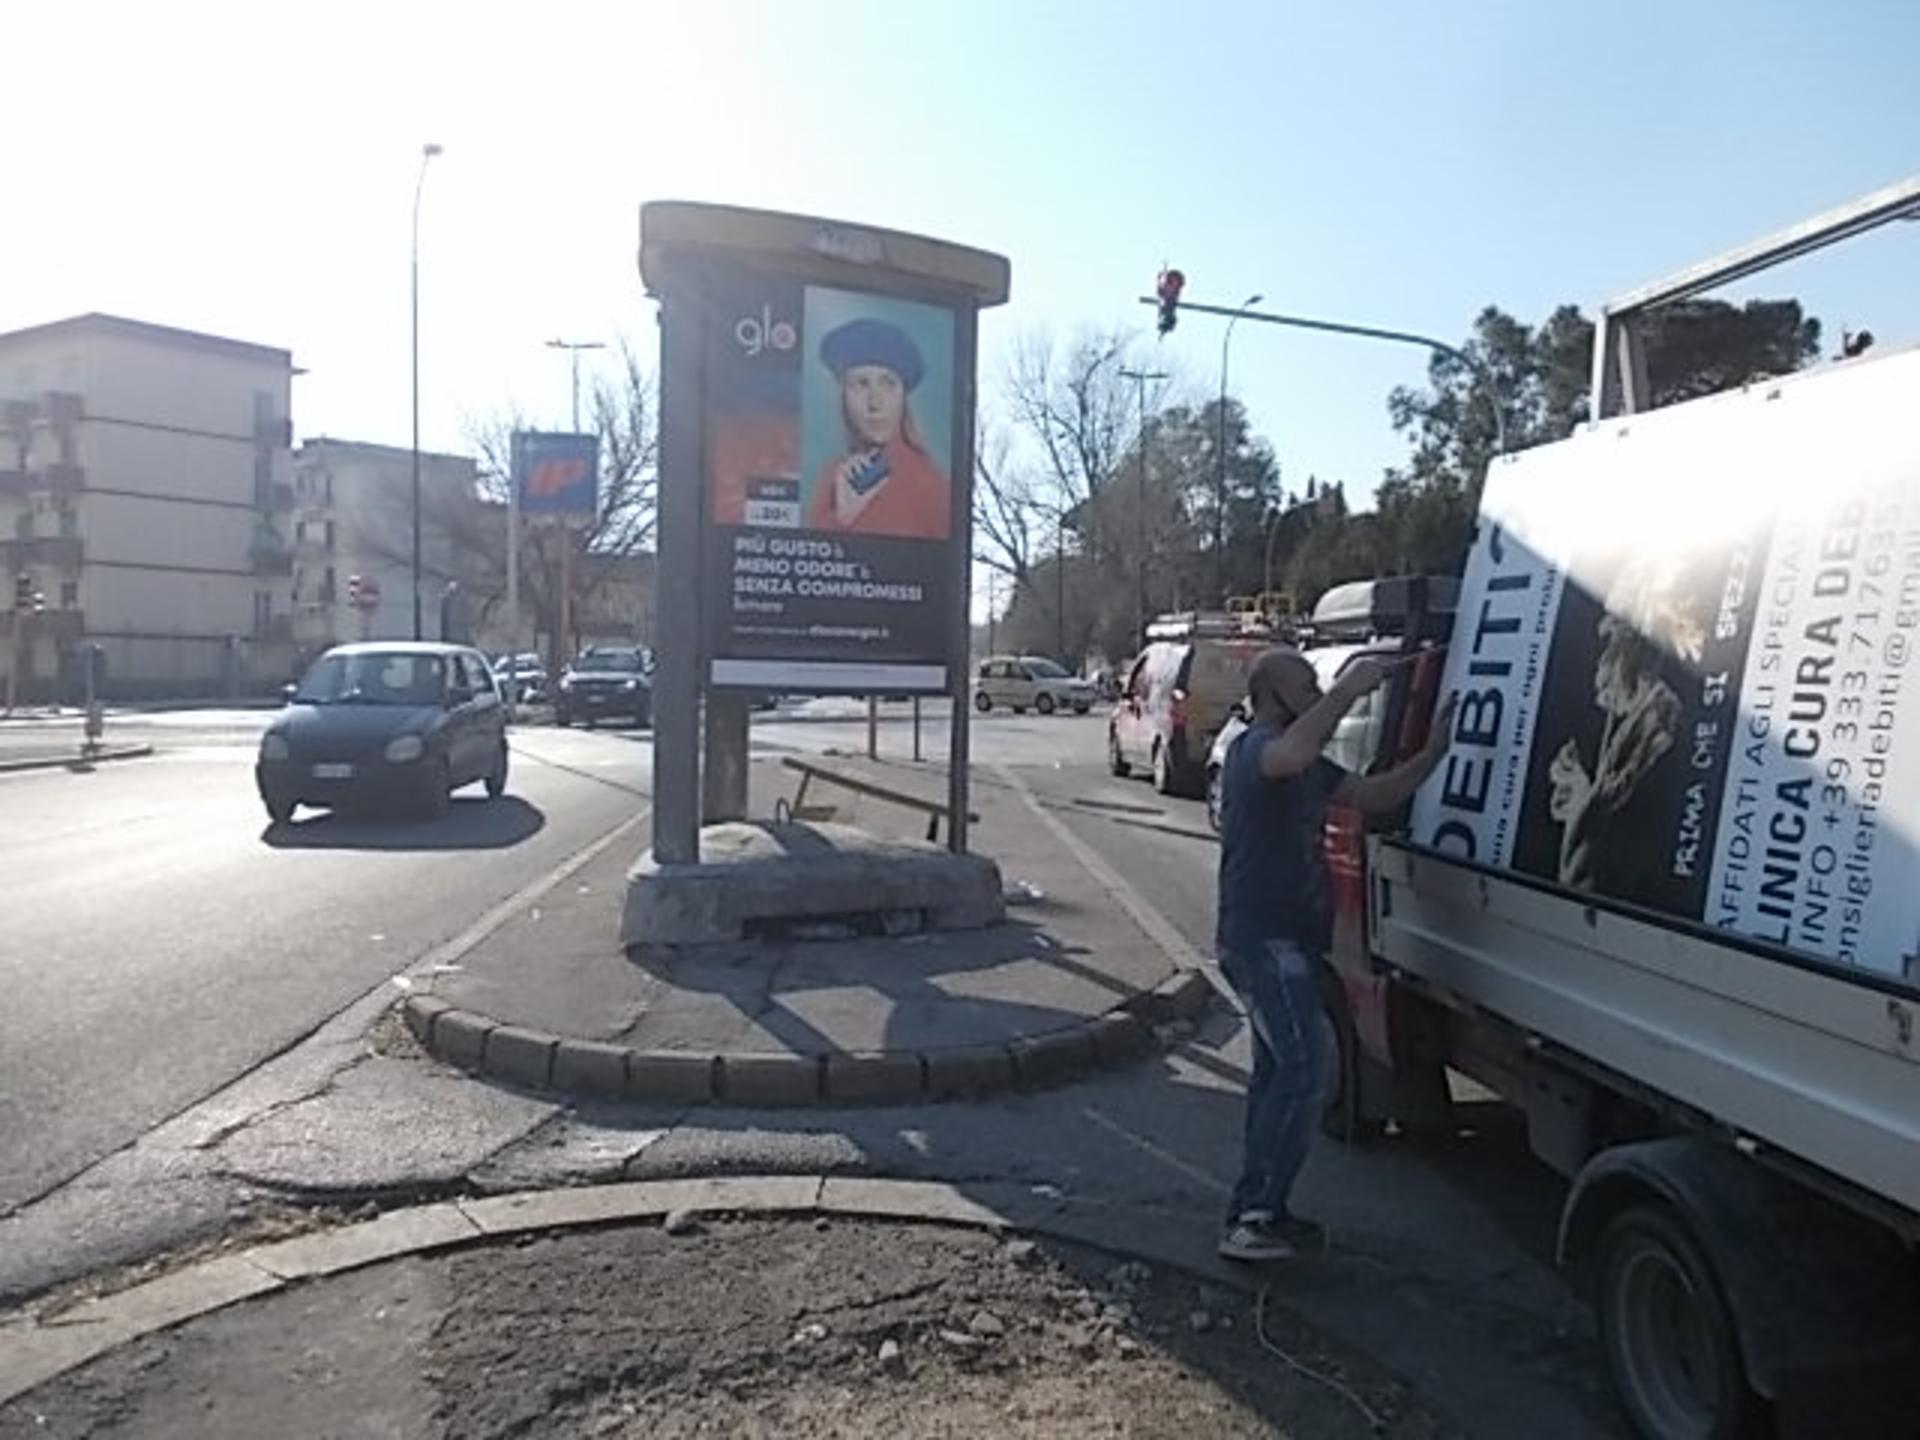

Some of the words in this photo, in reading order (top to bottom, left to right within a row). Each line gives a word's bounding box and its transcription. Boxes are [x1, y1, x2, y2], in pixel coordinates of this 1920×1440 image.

[736, 302, 797, 355] glo
[735, 557, 791, 575] MENO
[769, 539, 832, 558] GUSTO
[734, 575, 795, 594] SENZA
[797, 578, 923, 601] COMPROMESSI
[1703, 670, 1729, 707] SI
[1783, 615, 1843, 759] CURA
[1691, 721, 1718, 770] CHE
[1673, 782, 1706, 878] PRIMA
[1717, 778, 1760, 929] AFFIDATI
[1745, 685, 1776, 767] AGLI
[1801, 844, 1837, 944] INFO
[1822, 757, 1852, 830] +39
